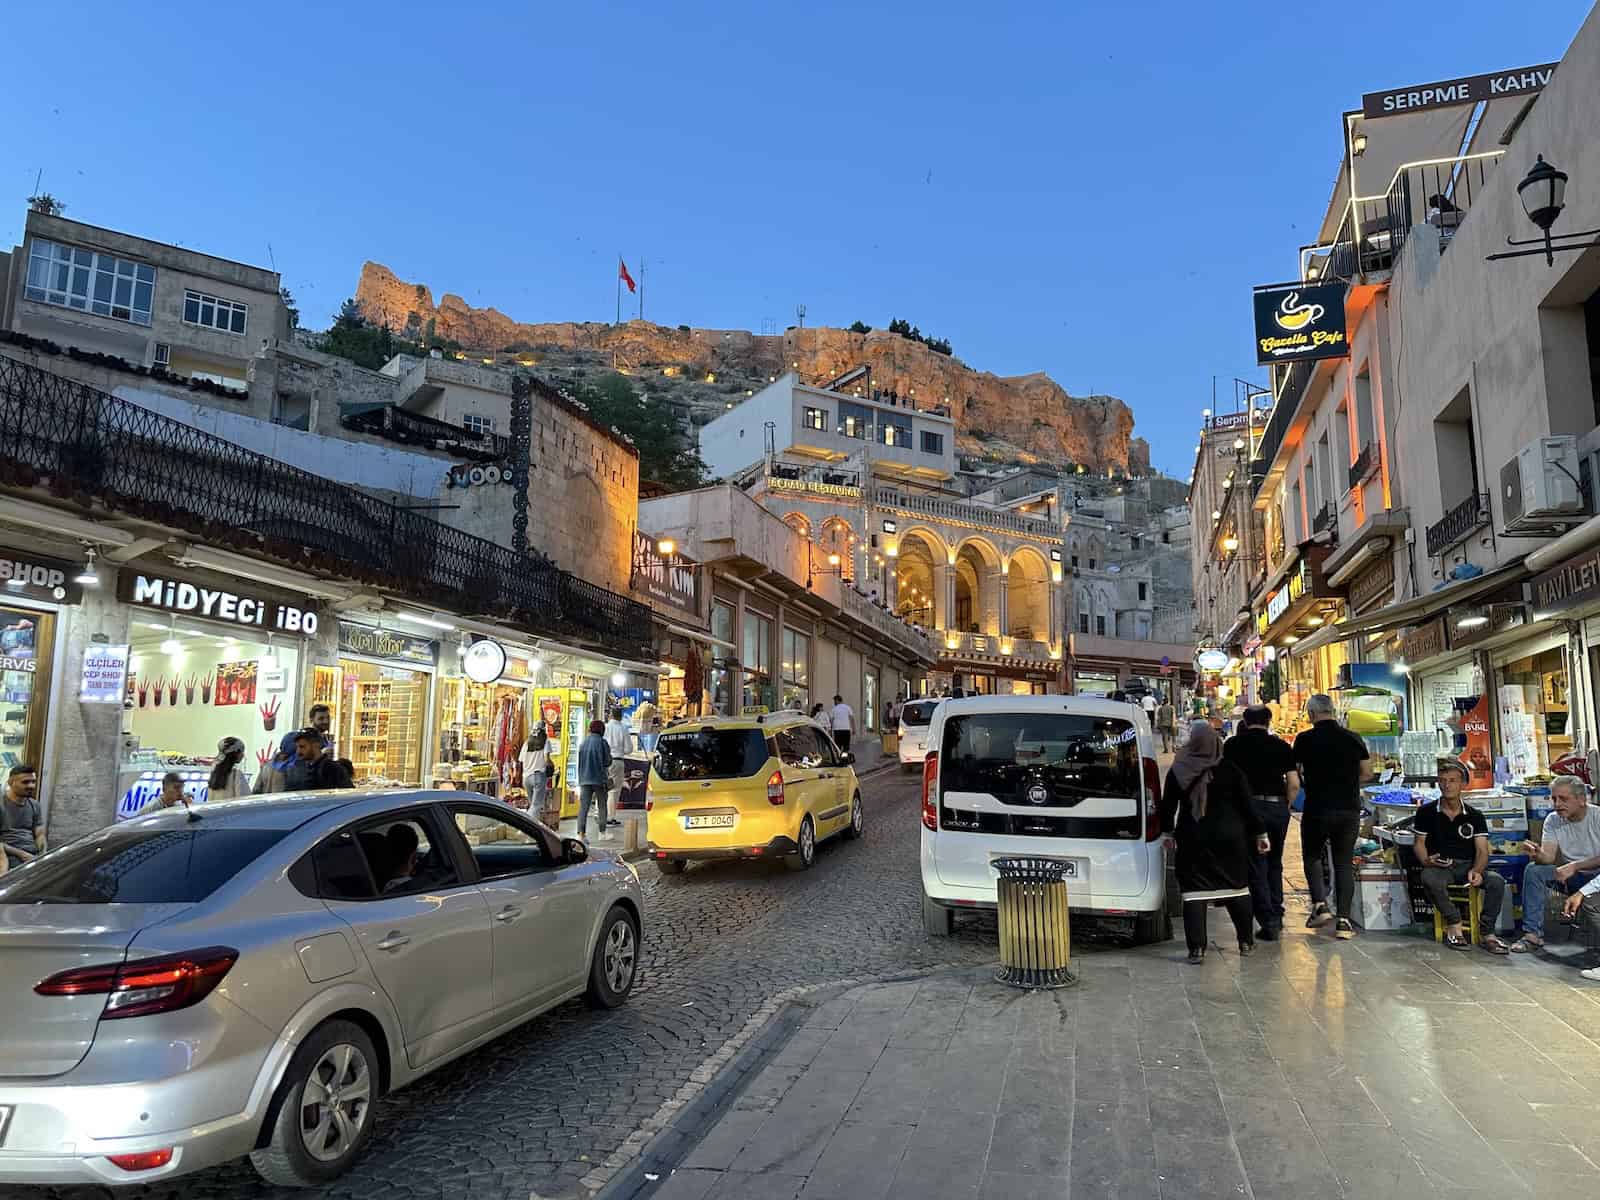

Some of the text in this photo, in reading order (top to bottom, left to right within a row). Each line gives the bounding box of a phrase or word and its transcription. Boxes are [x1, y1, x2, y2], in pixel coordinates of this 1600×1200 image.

[1383, 83, 1470, 111] SERPME
[1311, 330, 1344, 346] Cafe
[0, 558, 65, 587] SHOP
